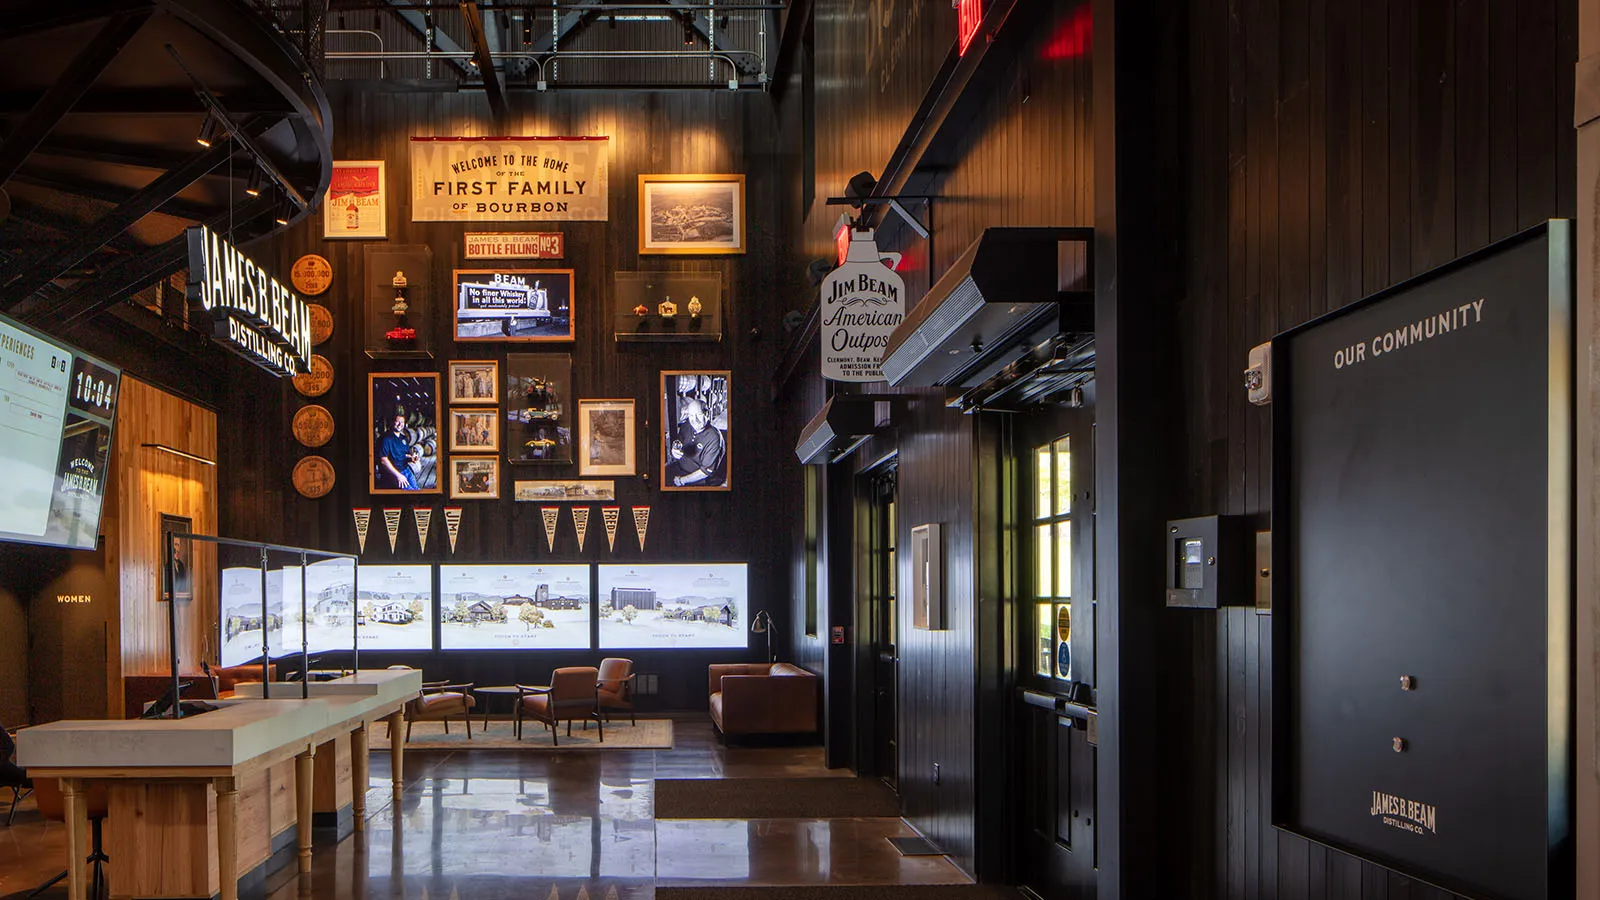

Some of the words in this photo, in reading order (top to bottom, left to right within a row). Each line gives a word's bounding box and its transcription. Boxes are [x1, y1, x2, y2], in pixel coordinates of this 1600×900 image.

[452, 155, 497, 174] WELCOME
[503, 154, 515, 166] TO
[521, 155, 538, 167] THE
[543, 158, 569, 173] HOME
[434, 181, 497, 195] FIRST
[508, 181, 586, 195] FAMILY
[332, 198, 348, 206] JIM
[356, 198, 379, 207] BEAM
[476, 202, 568, 213] BOURBON
[469, 243, 502, 255] BOTTLE
[505, 243, 538, 255] FILLING
[494, 273, 526, 285] BEAM
[828, 279, 855, 304] JIM
[858, 274, 898, 303] BEAM
[201, 224, 257, 315] JAMES
[258, 266, 272, 325] B.
[271, 277, 312, 374] BEAM
[469, 288, 480, 296] No
[824, 306, 902, 327] American
[831, 329, 888, 352] Outpos
[1334, 342, 1365, 369] OUR
[1372, 298, 1484, 356] COMMUNITY
[229, 316, 282, 368] DISTILLING
[284, 352, 297, 376] CO.
[77, 371, 112, 410] 10:04
[70, 458, 95, 473] WELCOME
[355, 511, 369, 531] JACOB
[385, 511, 400, 531] DAVID
[446, 511, 460, 532] JIM
[603, 510, 618, 530] FRED
[57, 595, 91, 603] WOMEN
[1371, 791, 1399, 816] JAMES
[1408, 800, 1436, 834] BEAM
[1383, 816, 1413, 832] DISTILLING
